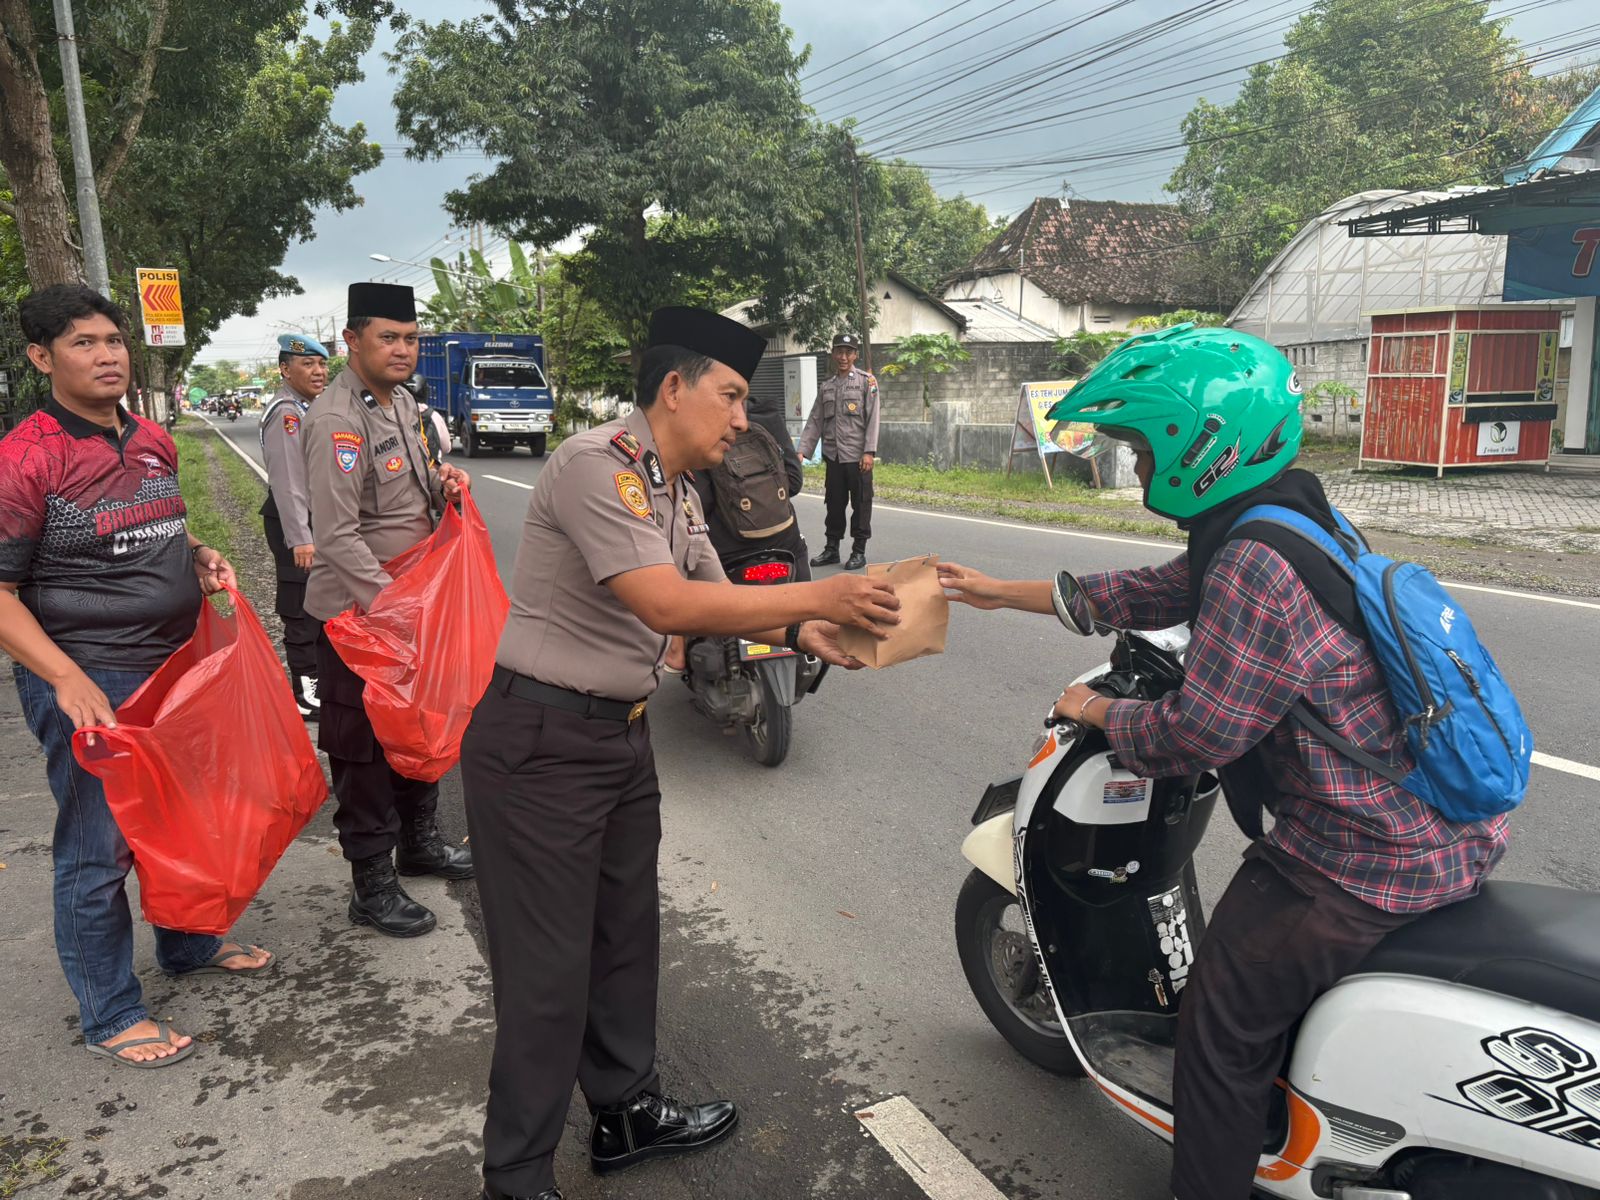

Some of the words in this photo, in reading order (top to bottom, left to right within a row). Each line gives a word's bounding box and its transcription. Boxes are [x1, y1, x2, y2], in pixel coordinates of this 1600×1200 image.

[140, 272, 177, 281] POLISI
[1030, 390, 1039, 398] ES
[1041, 389, 1053, 398] TEH
[1053, 388, 1071, 397] JUM
[374, 435, 400, 457] ANDRI
